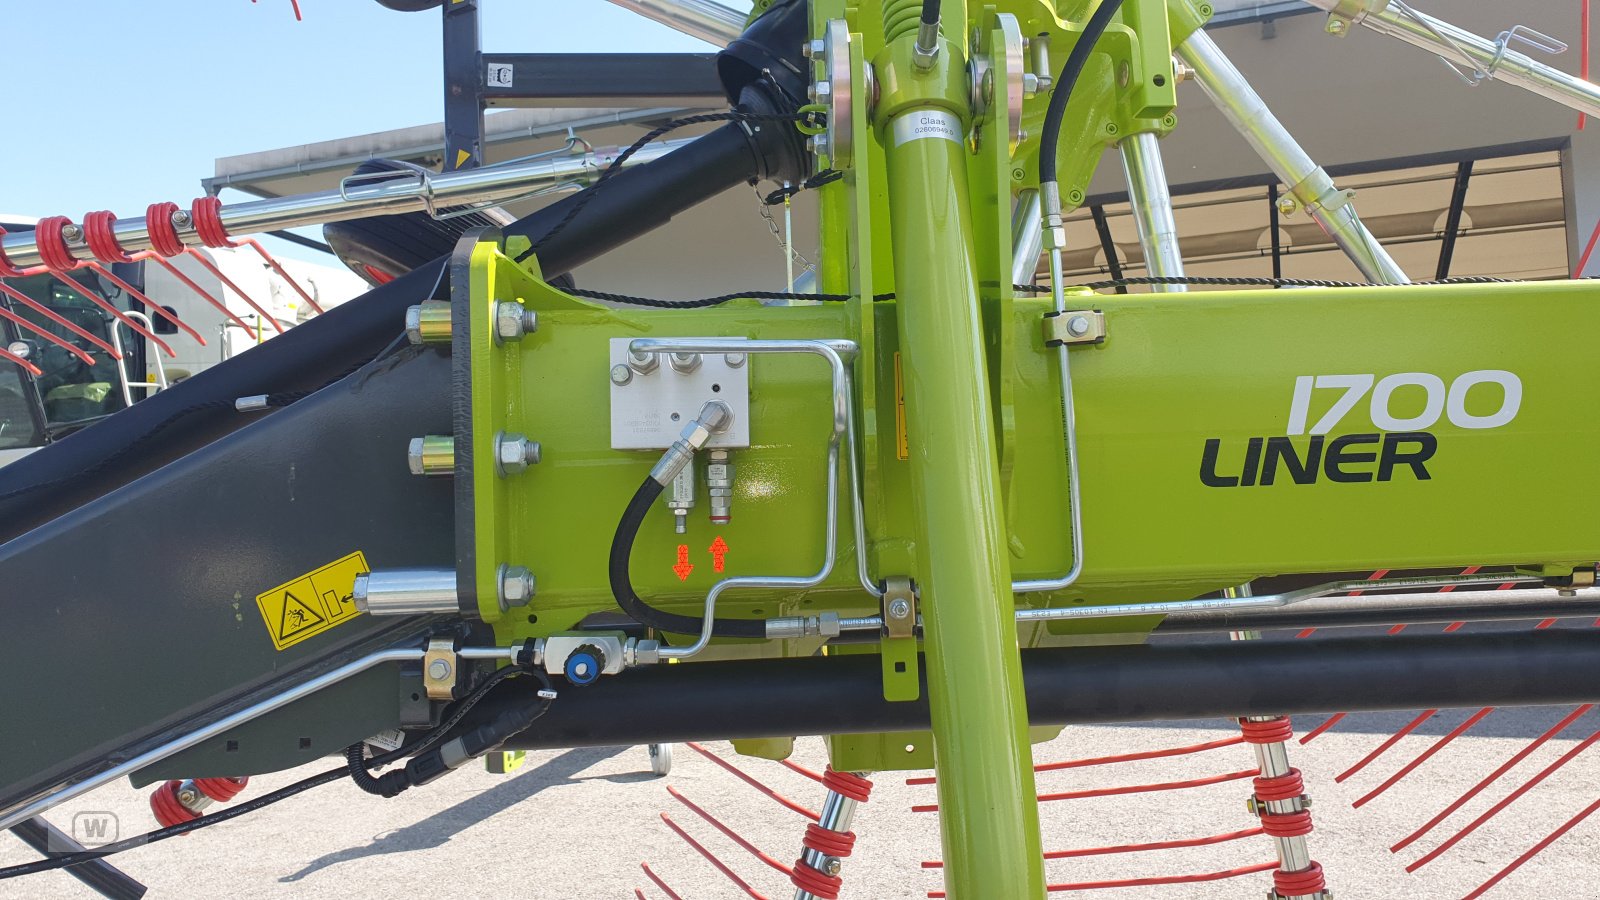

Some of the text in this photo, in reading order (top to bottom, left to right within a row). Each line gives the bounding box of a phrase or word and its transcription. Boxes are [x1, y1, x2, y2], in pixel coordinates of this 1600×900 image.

[920, 117, 946, 126] Claas
[1286, 369, 1523, 435] 1700
[1199, 431, 1438, 488] LINER
